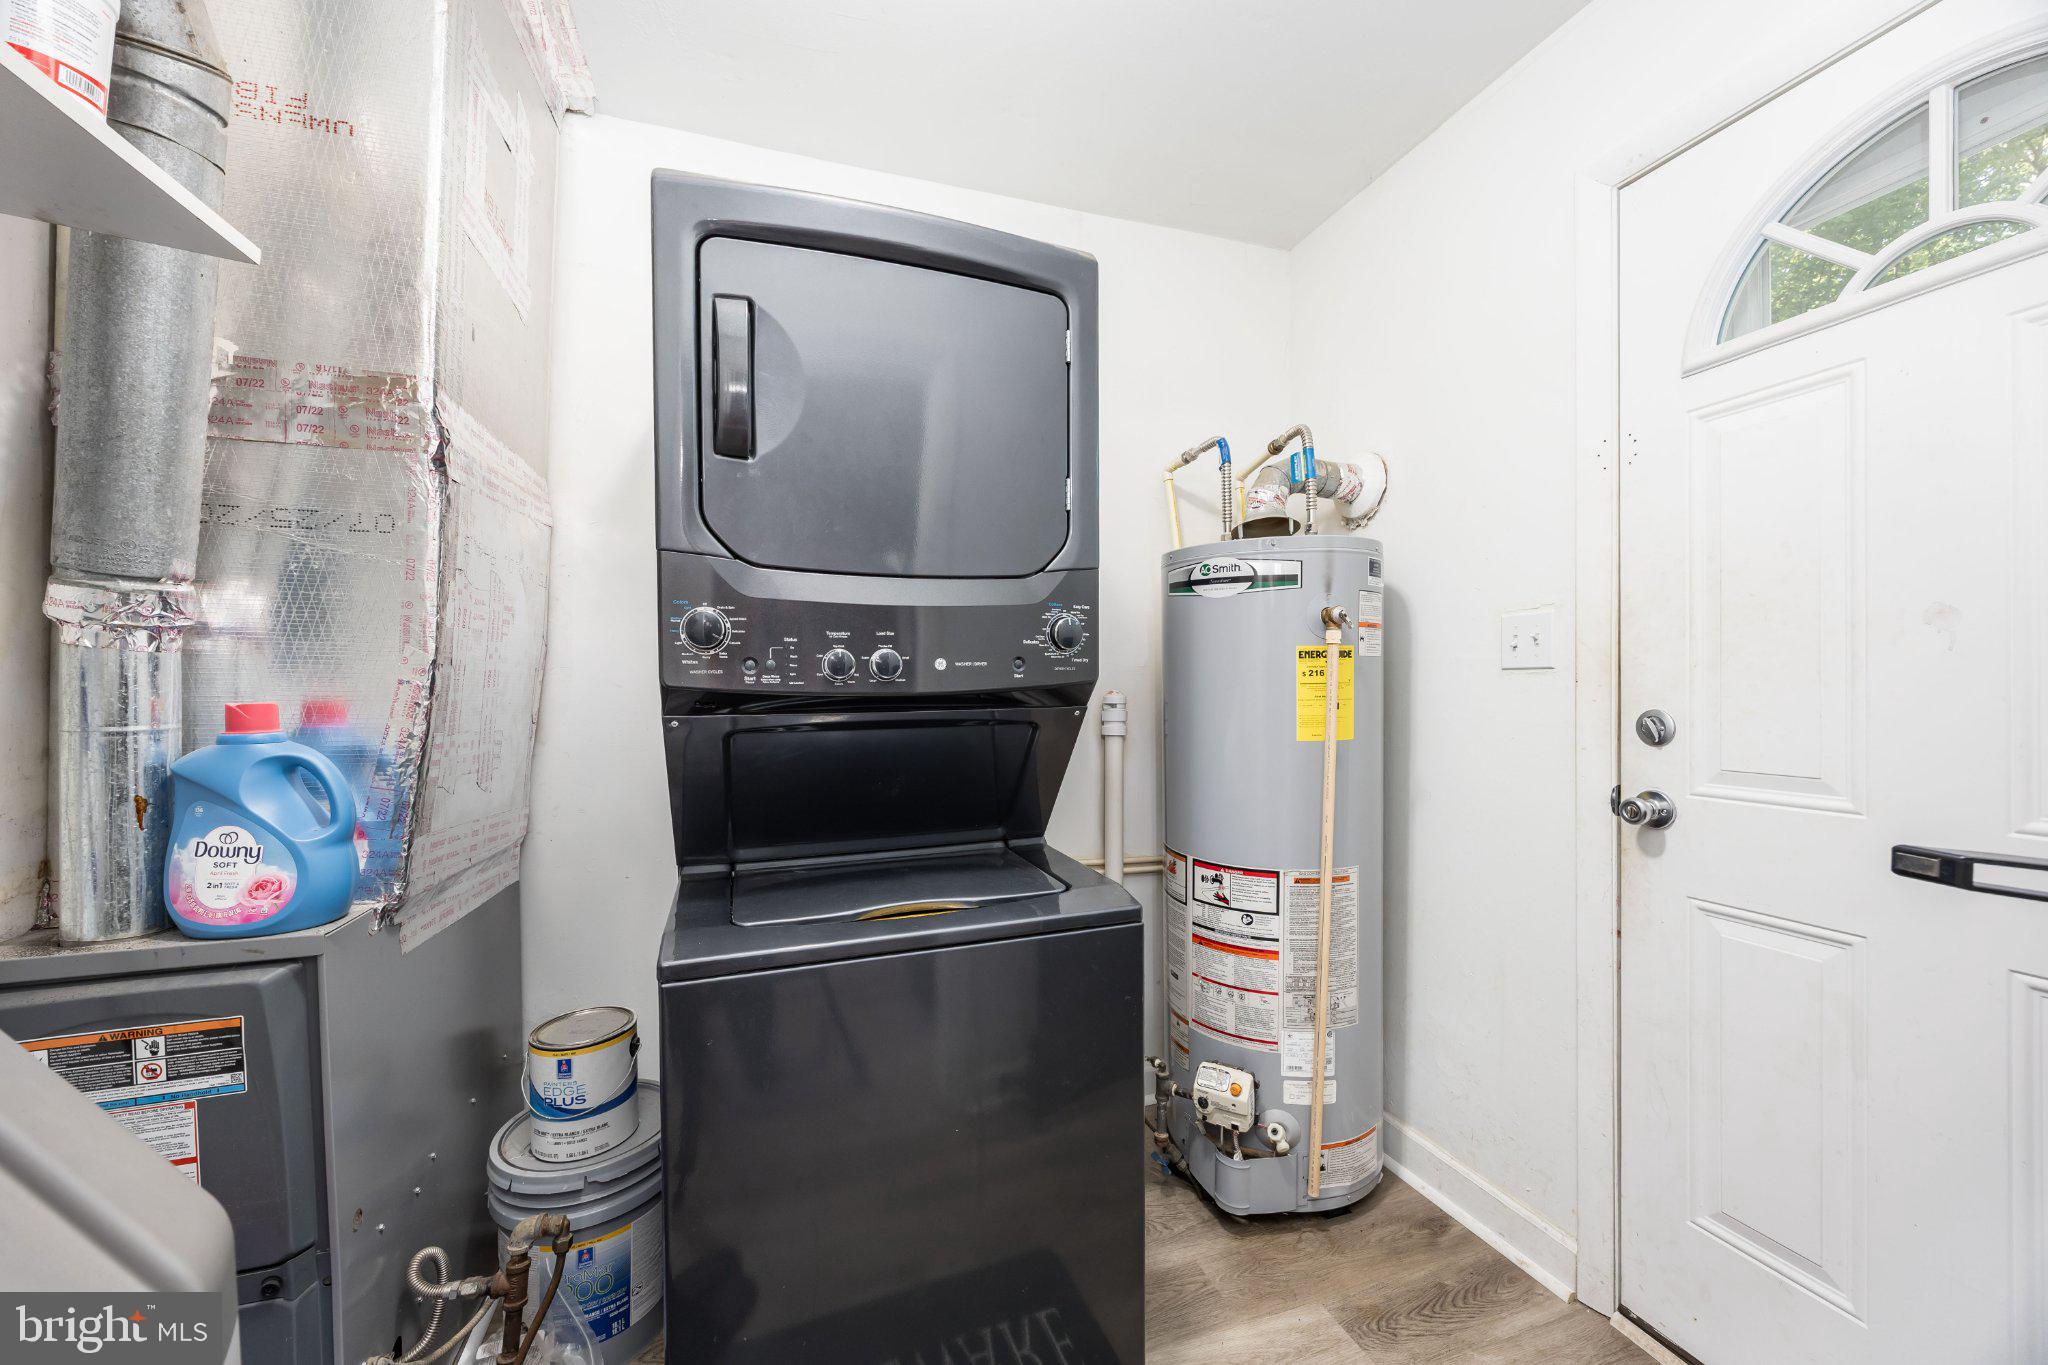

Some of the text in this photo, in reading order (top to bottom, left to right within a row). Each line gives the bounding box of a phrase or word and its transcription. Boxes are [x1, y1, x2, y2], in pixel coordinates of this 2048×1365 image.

[235, 377, 265, 388] 07/22
[296, 405, 324, 416] 07/22
[296, 422, 325, 434] 07/22
[405, 558, 416, 581] 07/22
[1212, 563, 1241, 574] Smith
[194, 841, 262, 865] Downy
[213, 861, 238, 869] SOFT
[109, 1028, 163, 1041] WARNING
[543, 1084, 587, 1096] EDGE
[544, 1095, 587, 1107] PLUS
